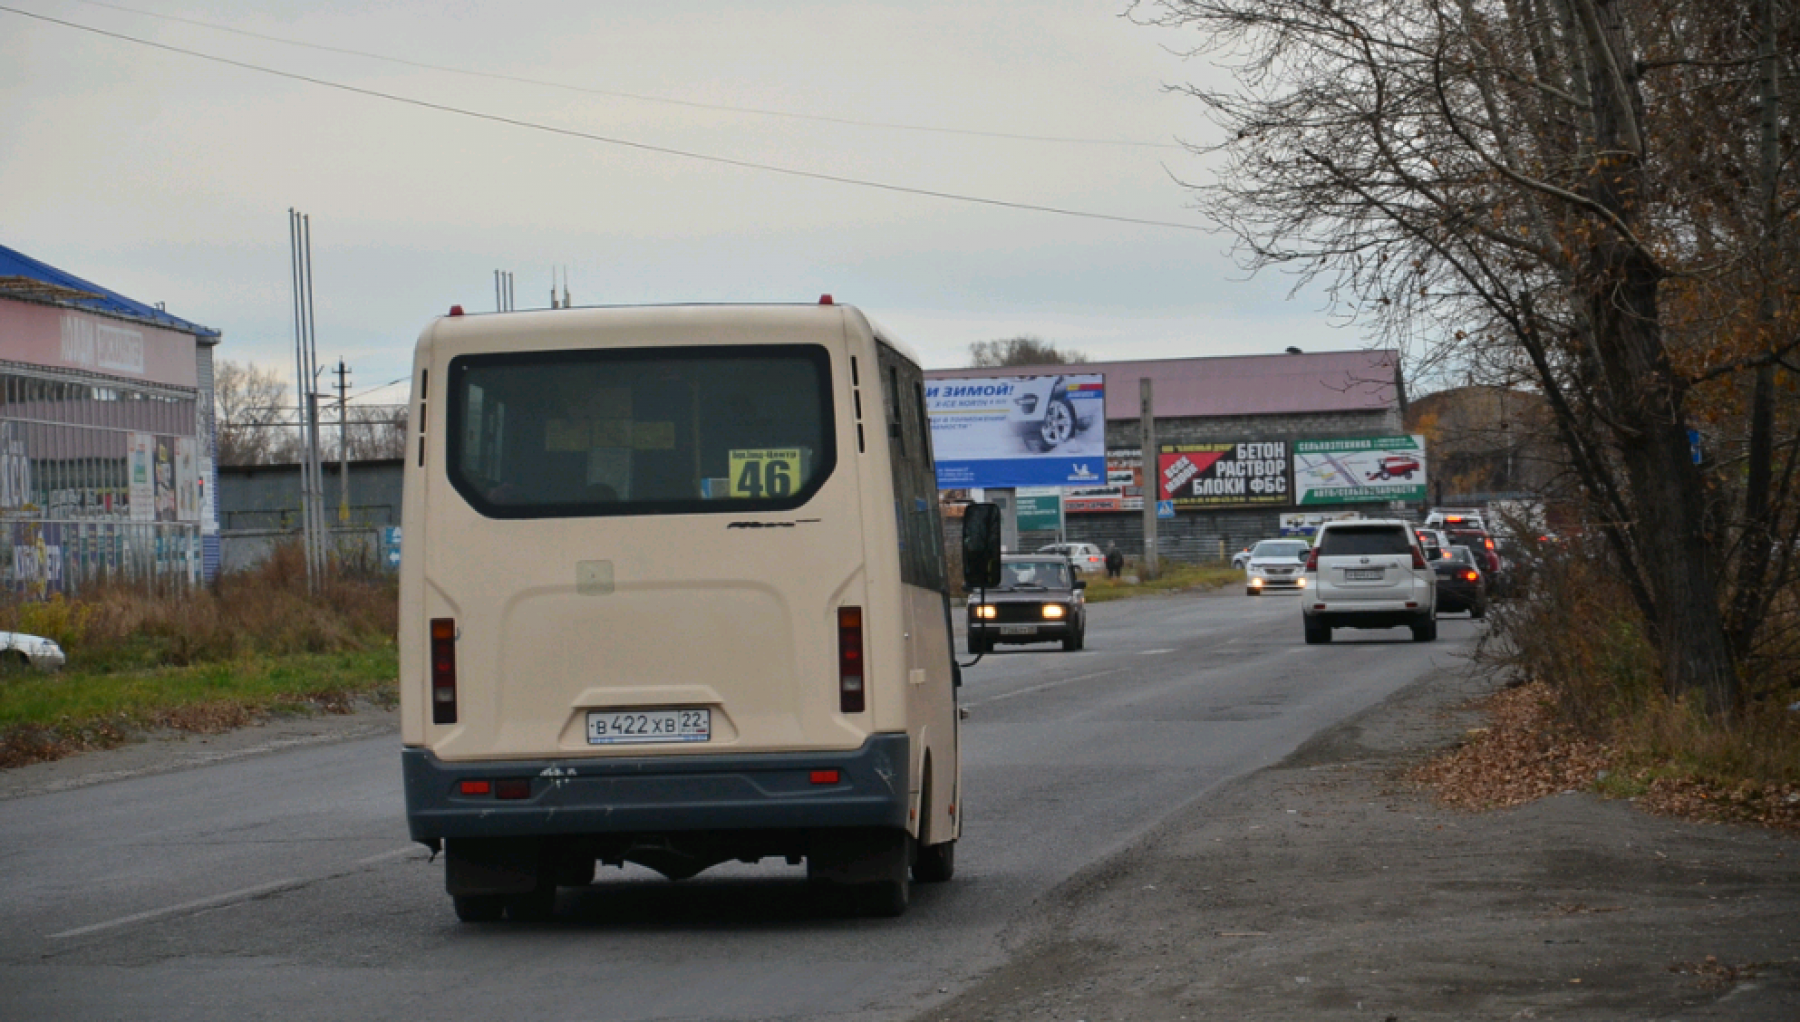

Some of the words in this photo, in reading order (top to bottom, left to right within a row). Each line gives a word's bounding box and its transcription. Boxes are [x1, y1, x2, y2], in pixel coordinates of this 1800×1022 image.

[943, 382, 1014, 397] ЗИМОЙ!
[1236, 442, 1285, 459] БЕТОН
[1215, 460, 1286, 477] РАСТВОР
[737, 461, 791, 498] 46
[1192, 478, 1246, 495] БЛОКИ
[1250, 476, 1286, 493] ФБС
[683, 712, 702, 727] 22
